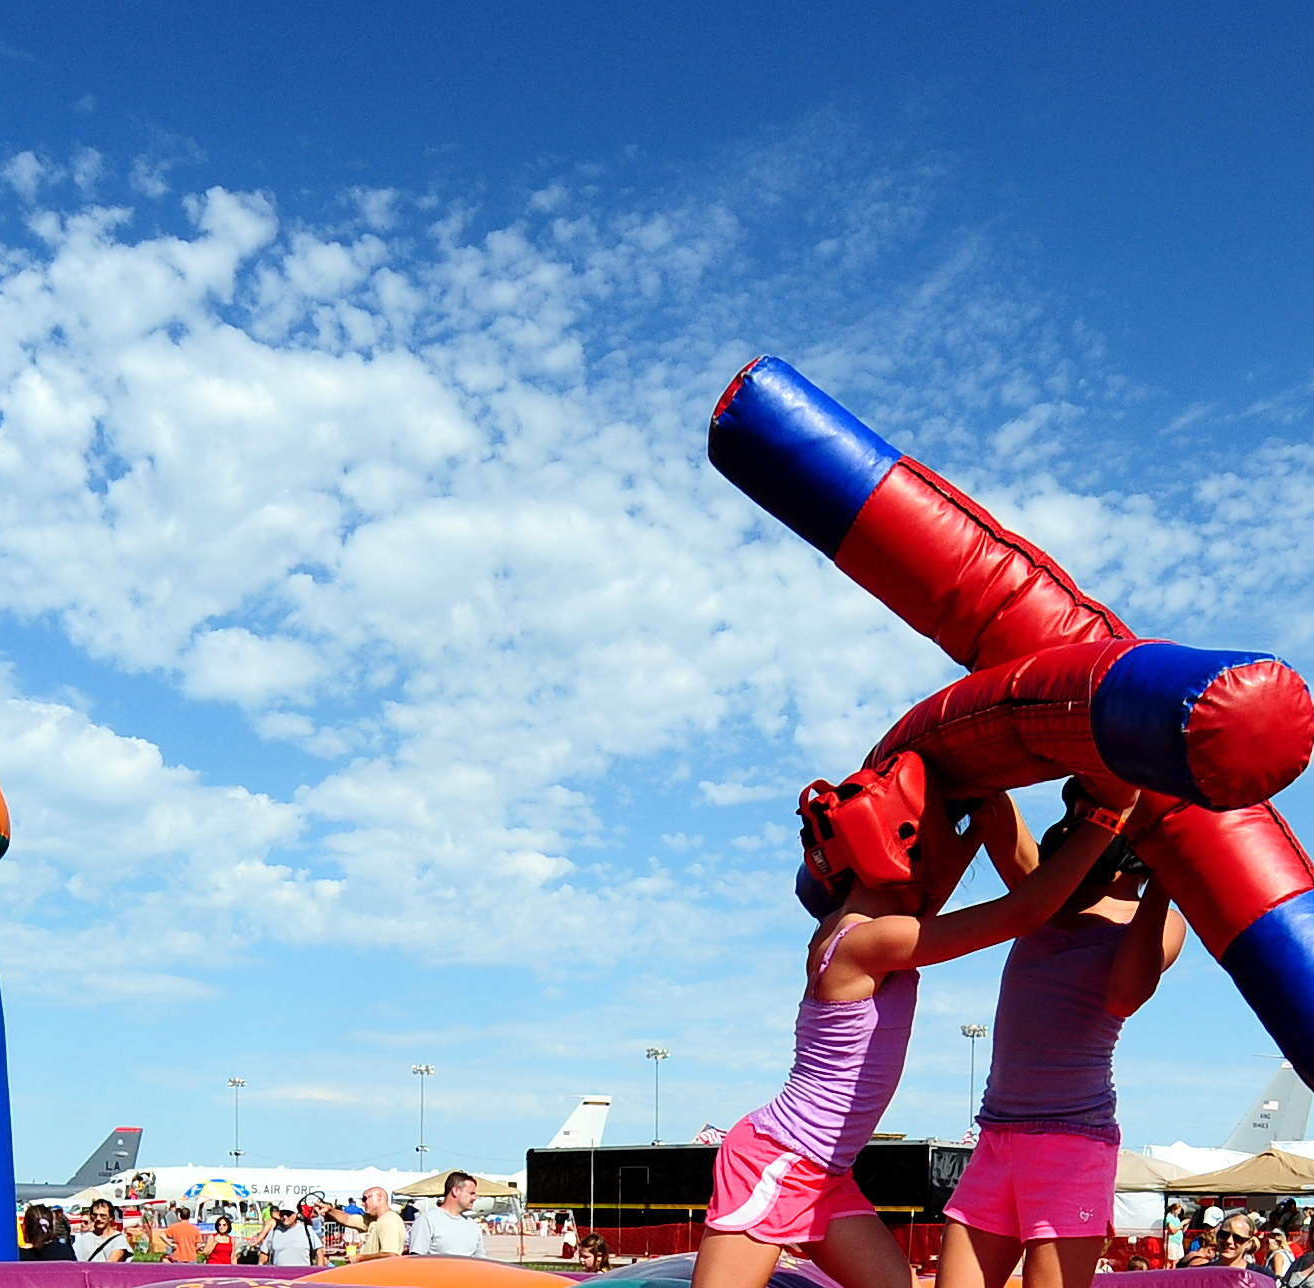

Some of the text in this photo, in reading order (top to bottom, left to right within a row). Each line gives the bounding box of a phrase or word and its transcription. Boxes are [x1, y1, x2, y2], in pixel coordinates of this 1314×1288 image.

[105, 1160, 121, 1171] LA
[263, 1184, 281, 1195] AIR
[285, 1185, 322, 1196] FORC
